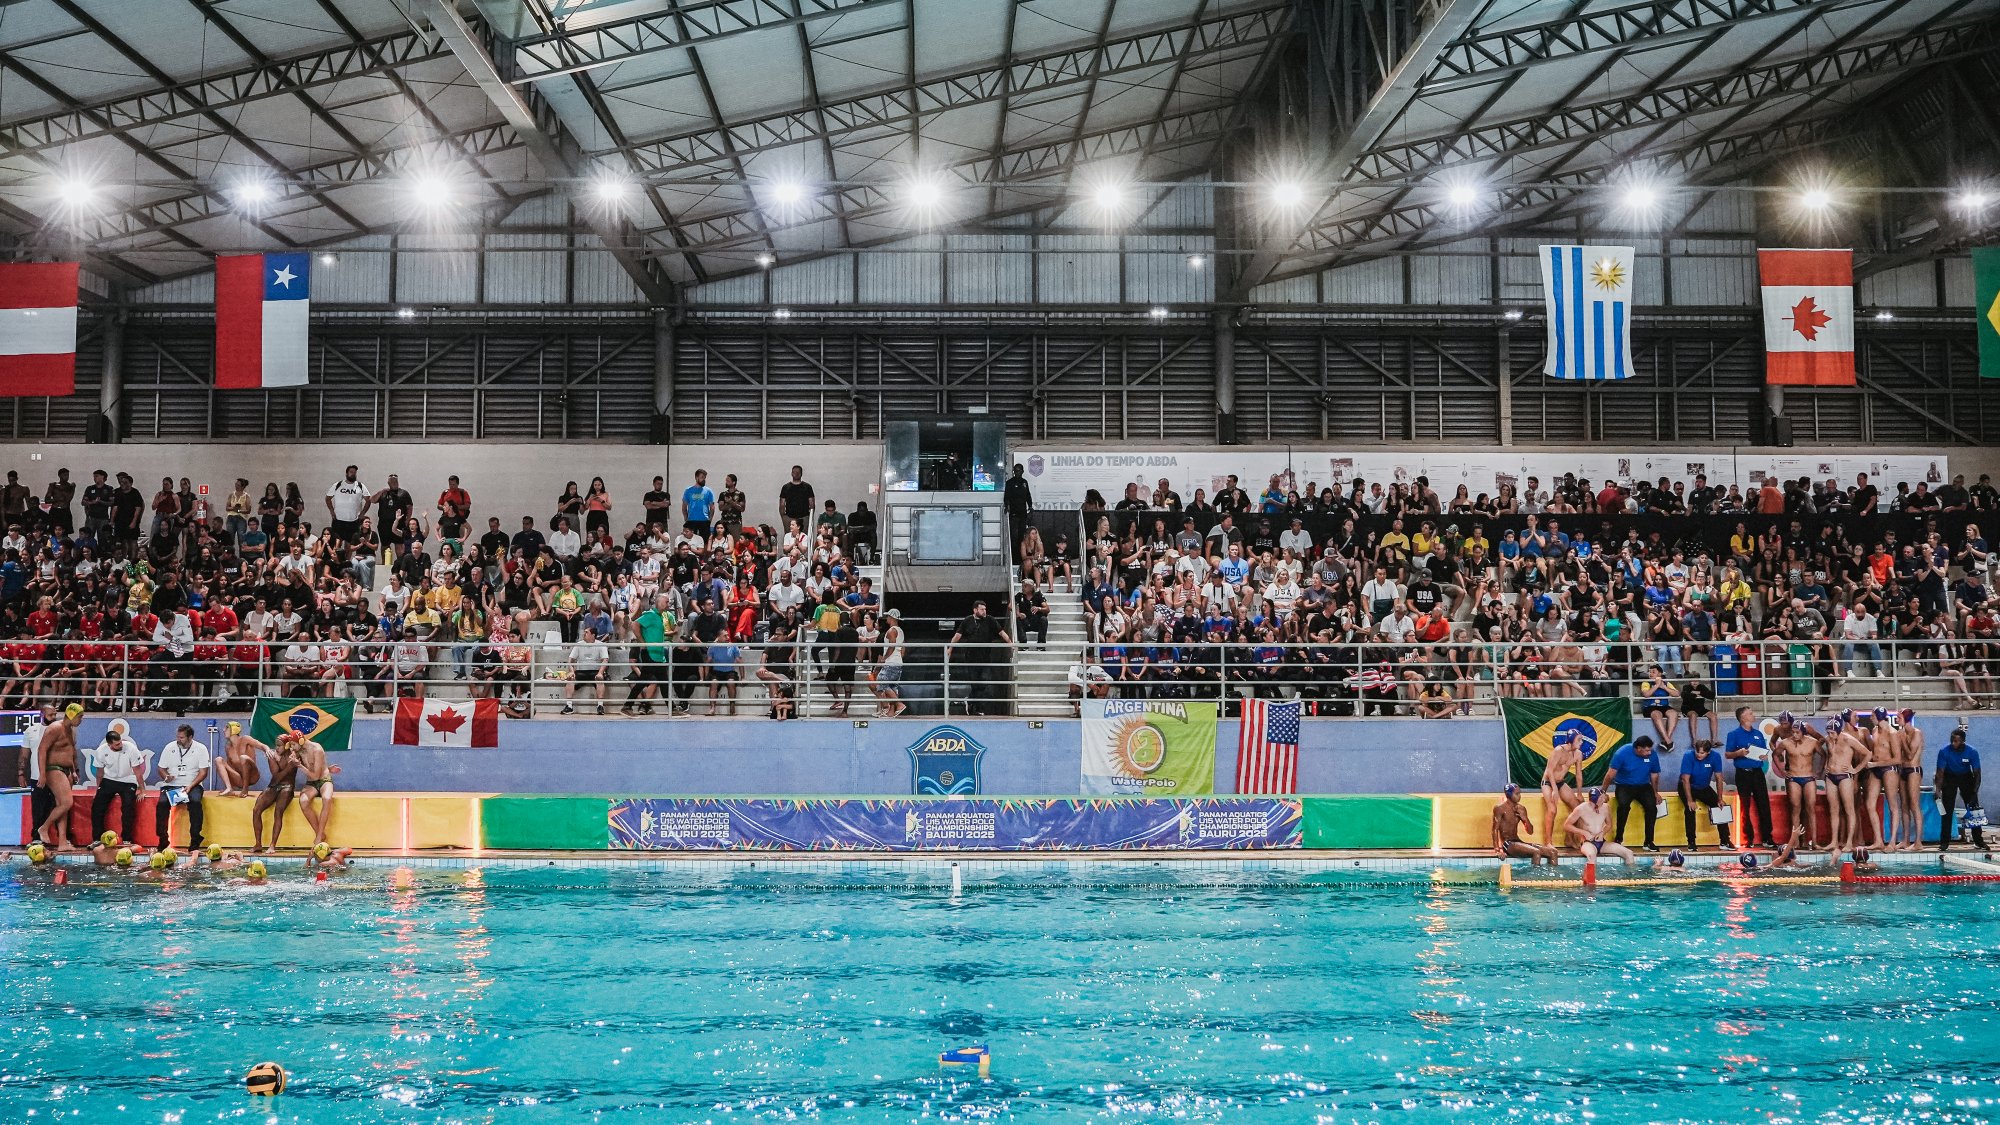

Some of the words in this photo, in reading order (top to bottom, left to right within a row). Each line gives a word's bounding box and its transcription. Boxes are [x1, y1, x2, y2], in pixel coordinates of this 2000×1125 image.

[1051, 456, 1084, 466] LINHA
[1086, 456, 1103, 466] DO
[1105, 456, 1145, 466] TEMPO
[1146, 456, 1178, 466] ABDA
[1224, 567, 1241, 576] USA
[1322, 571, 1338, 580] USA
[1417, 590, 1434, 599] USA
[1104, 700, 1187, 720] ARGENTINA
[924, 738, 966, 752] ABDA
[1112, 777, 1176, 787] WaterPolo
[926, 831, 964, 839] BAURU
[965, 831, 995, 839] 2025
[1199, 830, 1237, 838] BAURU
[1238, 830, 1268, 838] 2025
